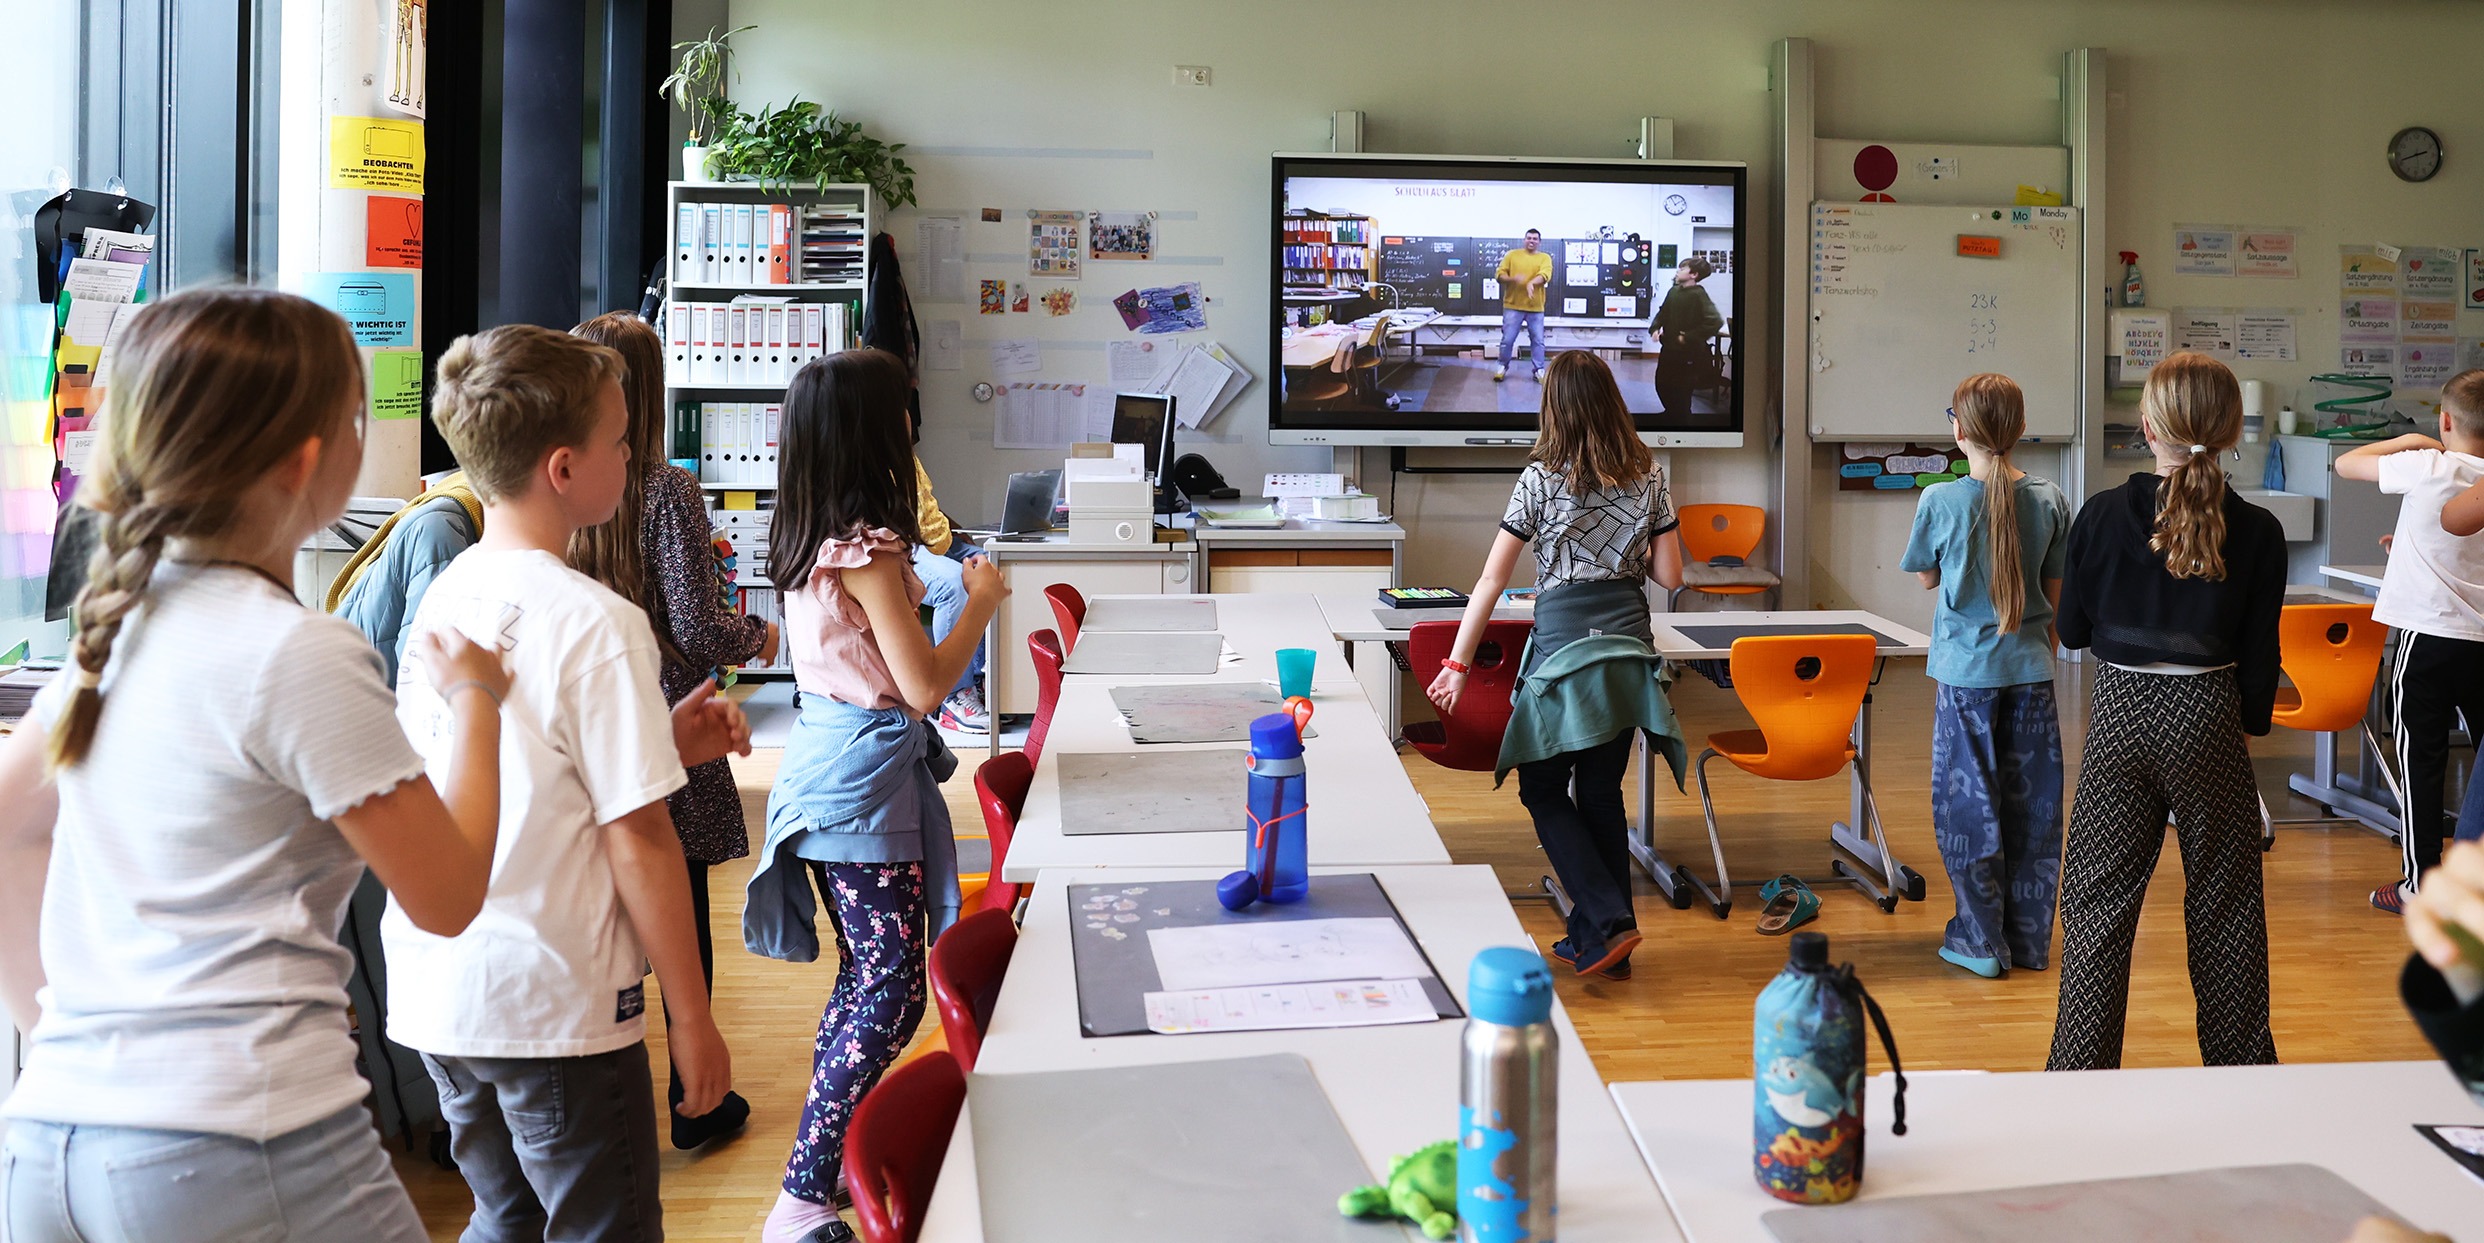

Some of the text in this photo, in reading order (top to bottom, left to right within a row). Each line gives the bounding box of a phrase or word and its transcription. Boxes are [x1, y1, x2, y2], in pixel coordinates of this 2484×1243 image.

[363, 159, 414, 170] BEOBACHTEN
[2013, 211, 2028, 221] Mo
[2040, 208, 2068, 220] Monday
[2180, 251, 2227, 259] Satzgegenstand
[2247, 253, 2287, 262] Satzaussage
[2349, 320, 2389, 328] Ortsangabe
[2410, 321, 2449, 330] Zeitangabe
